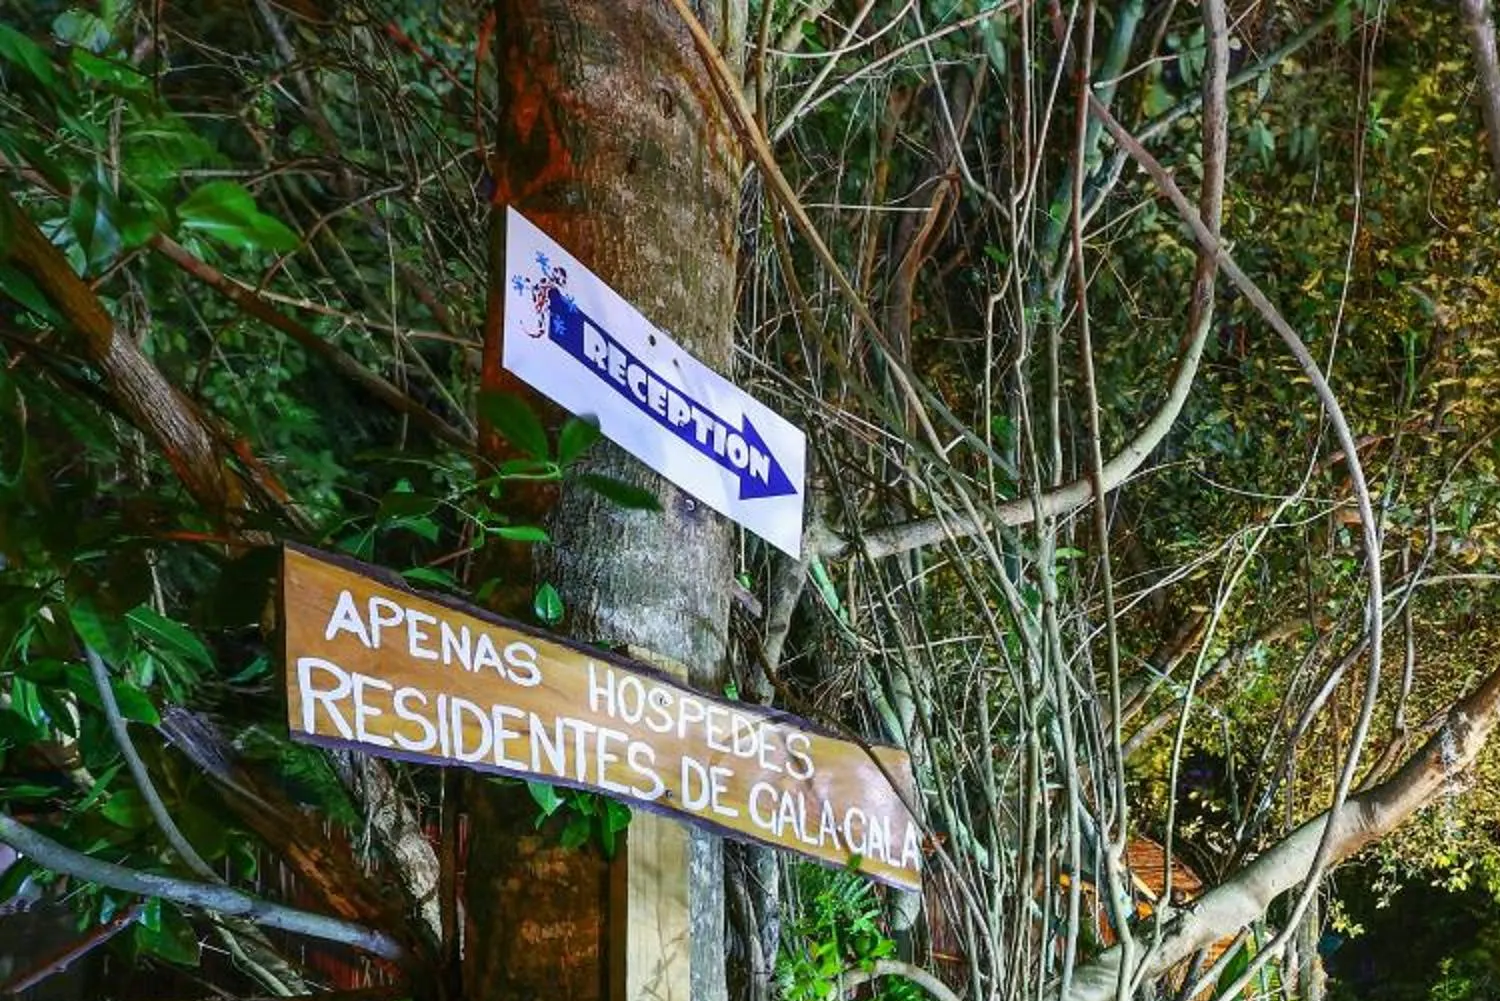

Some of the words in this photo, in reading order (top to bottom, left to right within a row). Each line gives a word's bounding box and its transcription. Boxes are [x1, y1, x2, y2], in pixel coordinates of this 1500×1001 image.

[582, 320, 773, 489] RECEPTION
[296, 656, 667, 801] RESIDENTES
[680, 755, 740, 818] DE
[324, 589, 543, 688] APENAS
[588, 661, 816, 782] HOSPEDES
